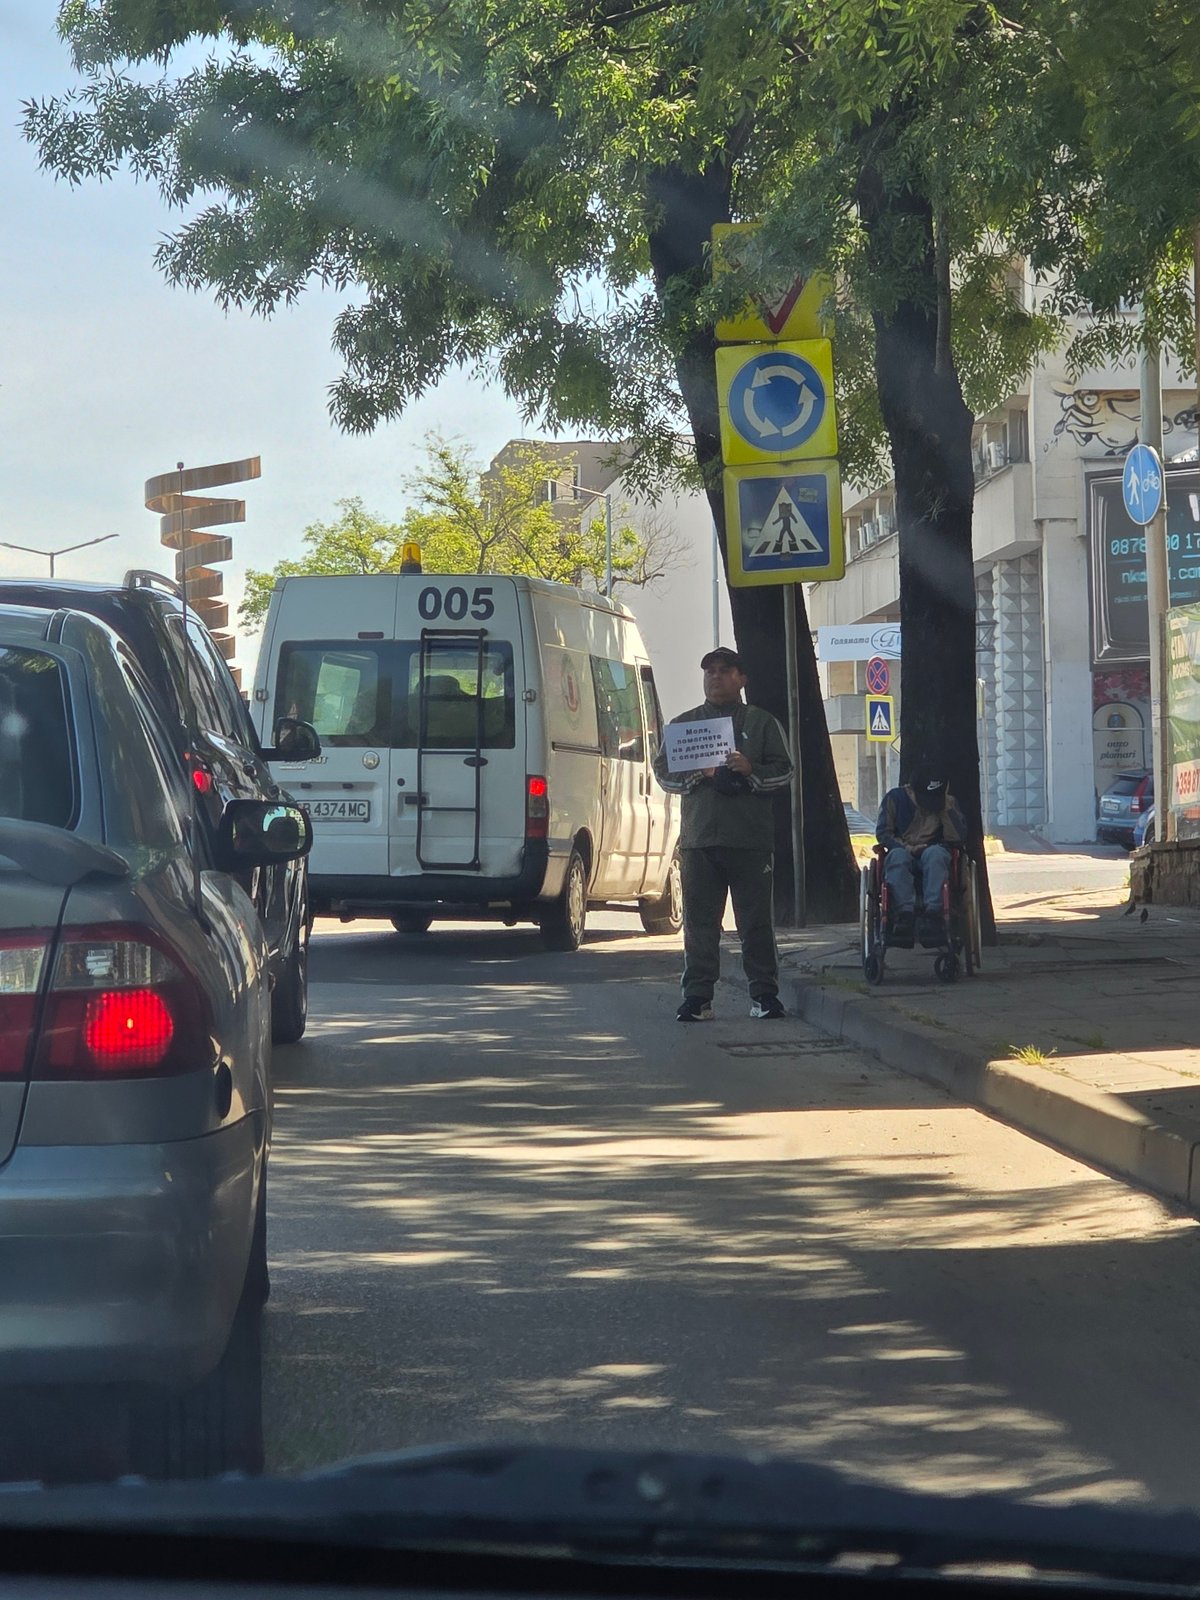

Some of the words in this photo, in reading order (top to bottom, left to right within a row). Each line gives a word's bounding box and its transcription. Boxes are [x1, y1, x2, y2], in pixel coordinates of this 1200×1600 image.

[418, 586, 495, 621] 005
[831, 637, 870, 646] Голямата
[685, 743, 714, 752] детето
[314, 802, 346, 816] 4374
[348, 802, 366, 816] MC
